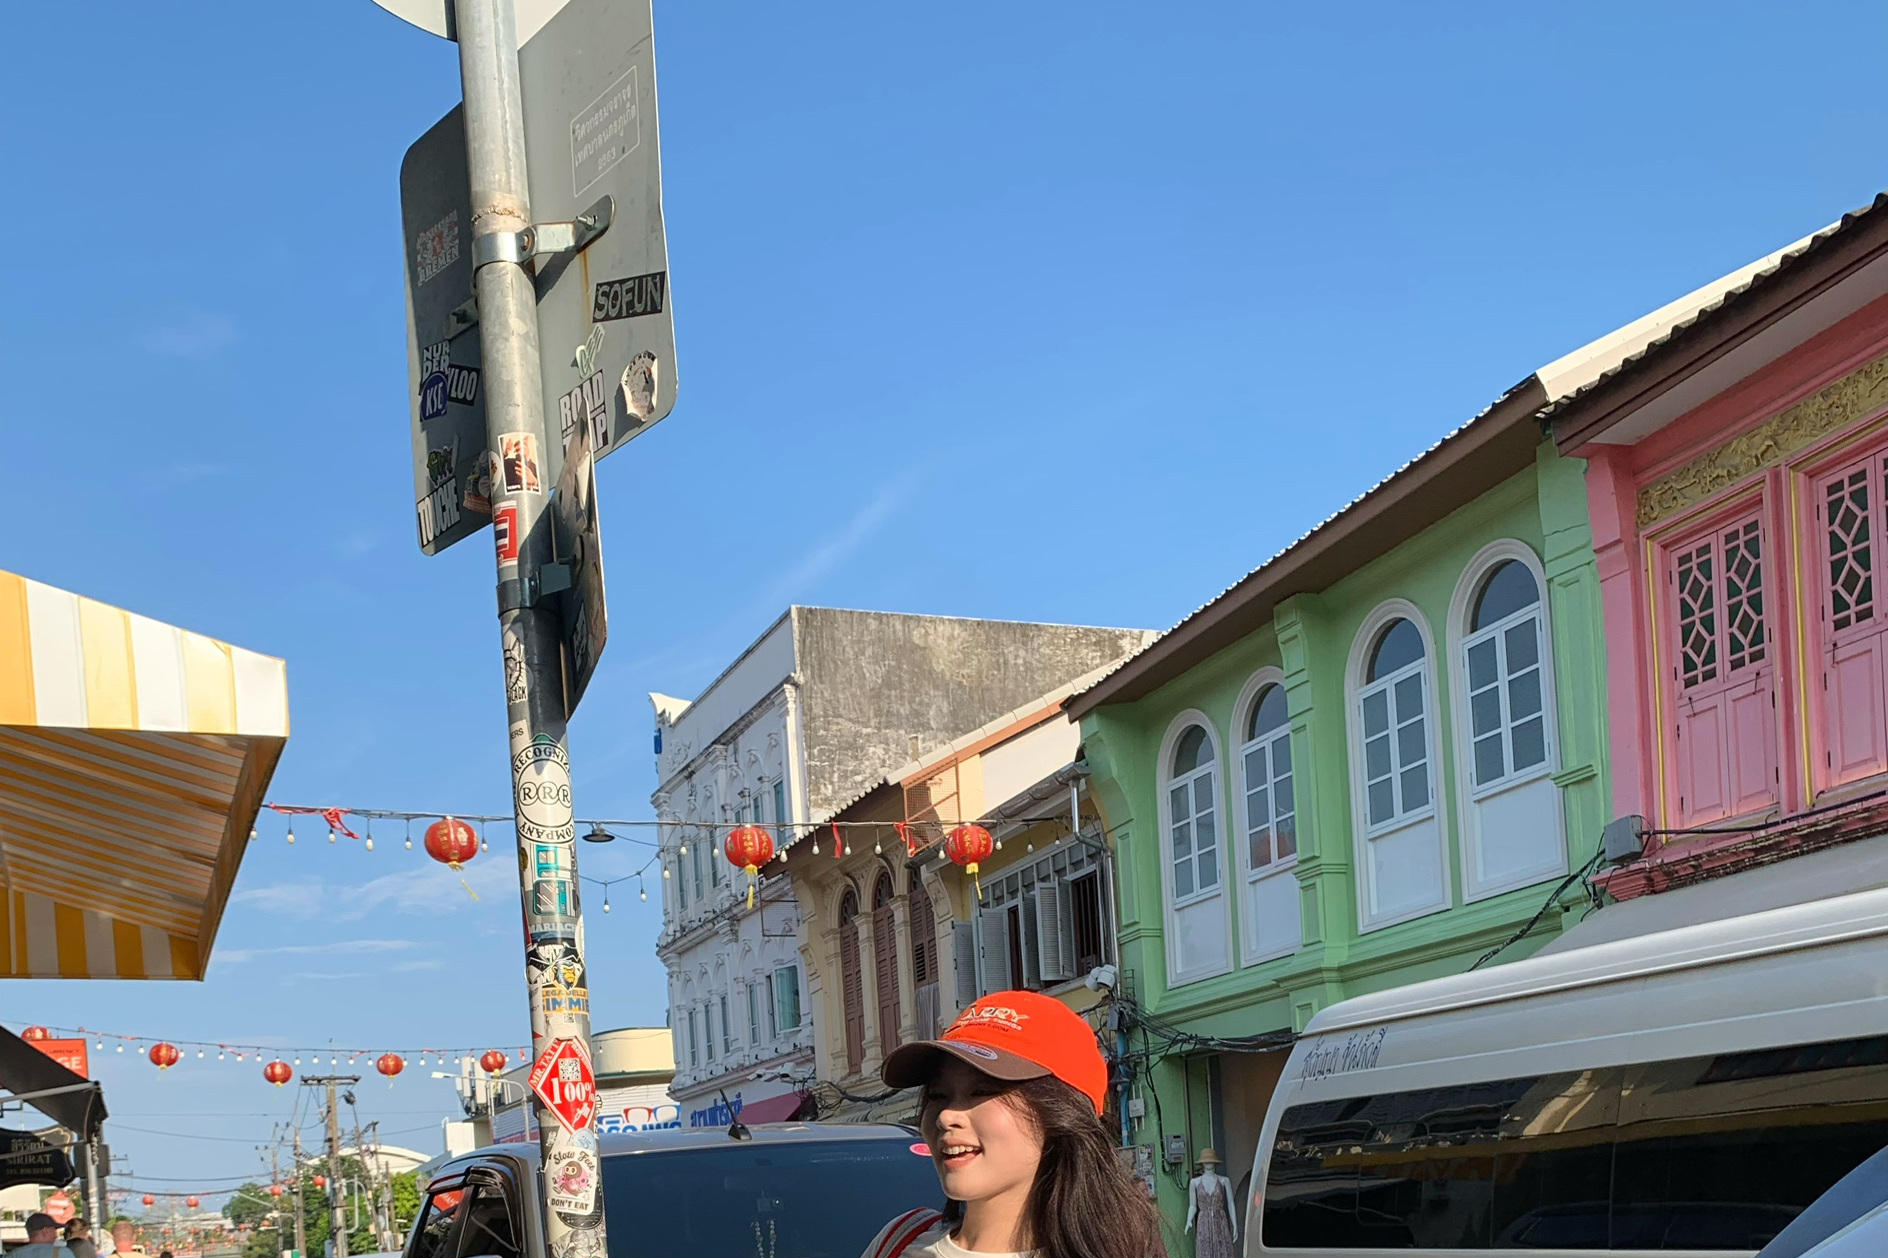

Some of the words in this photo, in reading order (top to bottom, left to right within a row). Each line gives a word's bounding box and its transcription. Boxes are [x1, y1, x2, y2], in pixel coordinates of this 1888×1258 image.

[593, 275, 662, 320] SOFUN
[423, 340, 450, 361] NUR
[422, 354, 450, 384] DER
[425, 381, 444, 417] KSC
[559, 371, 605, 430] ROAD
[417, 477, 461, 546] TOUCHE
[551, 1078, 596, 1105] 100%
[554, 1150, 575, 1165] Slow
[551, 1198, 572, 1207] DON'T
[574, 1201, 589, 1210] EAT
